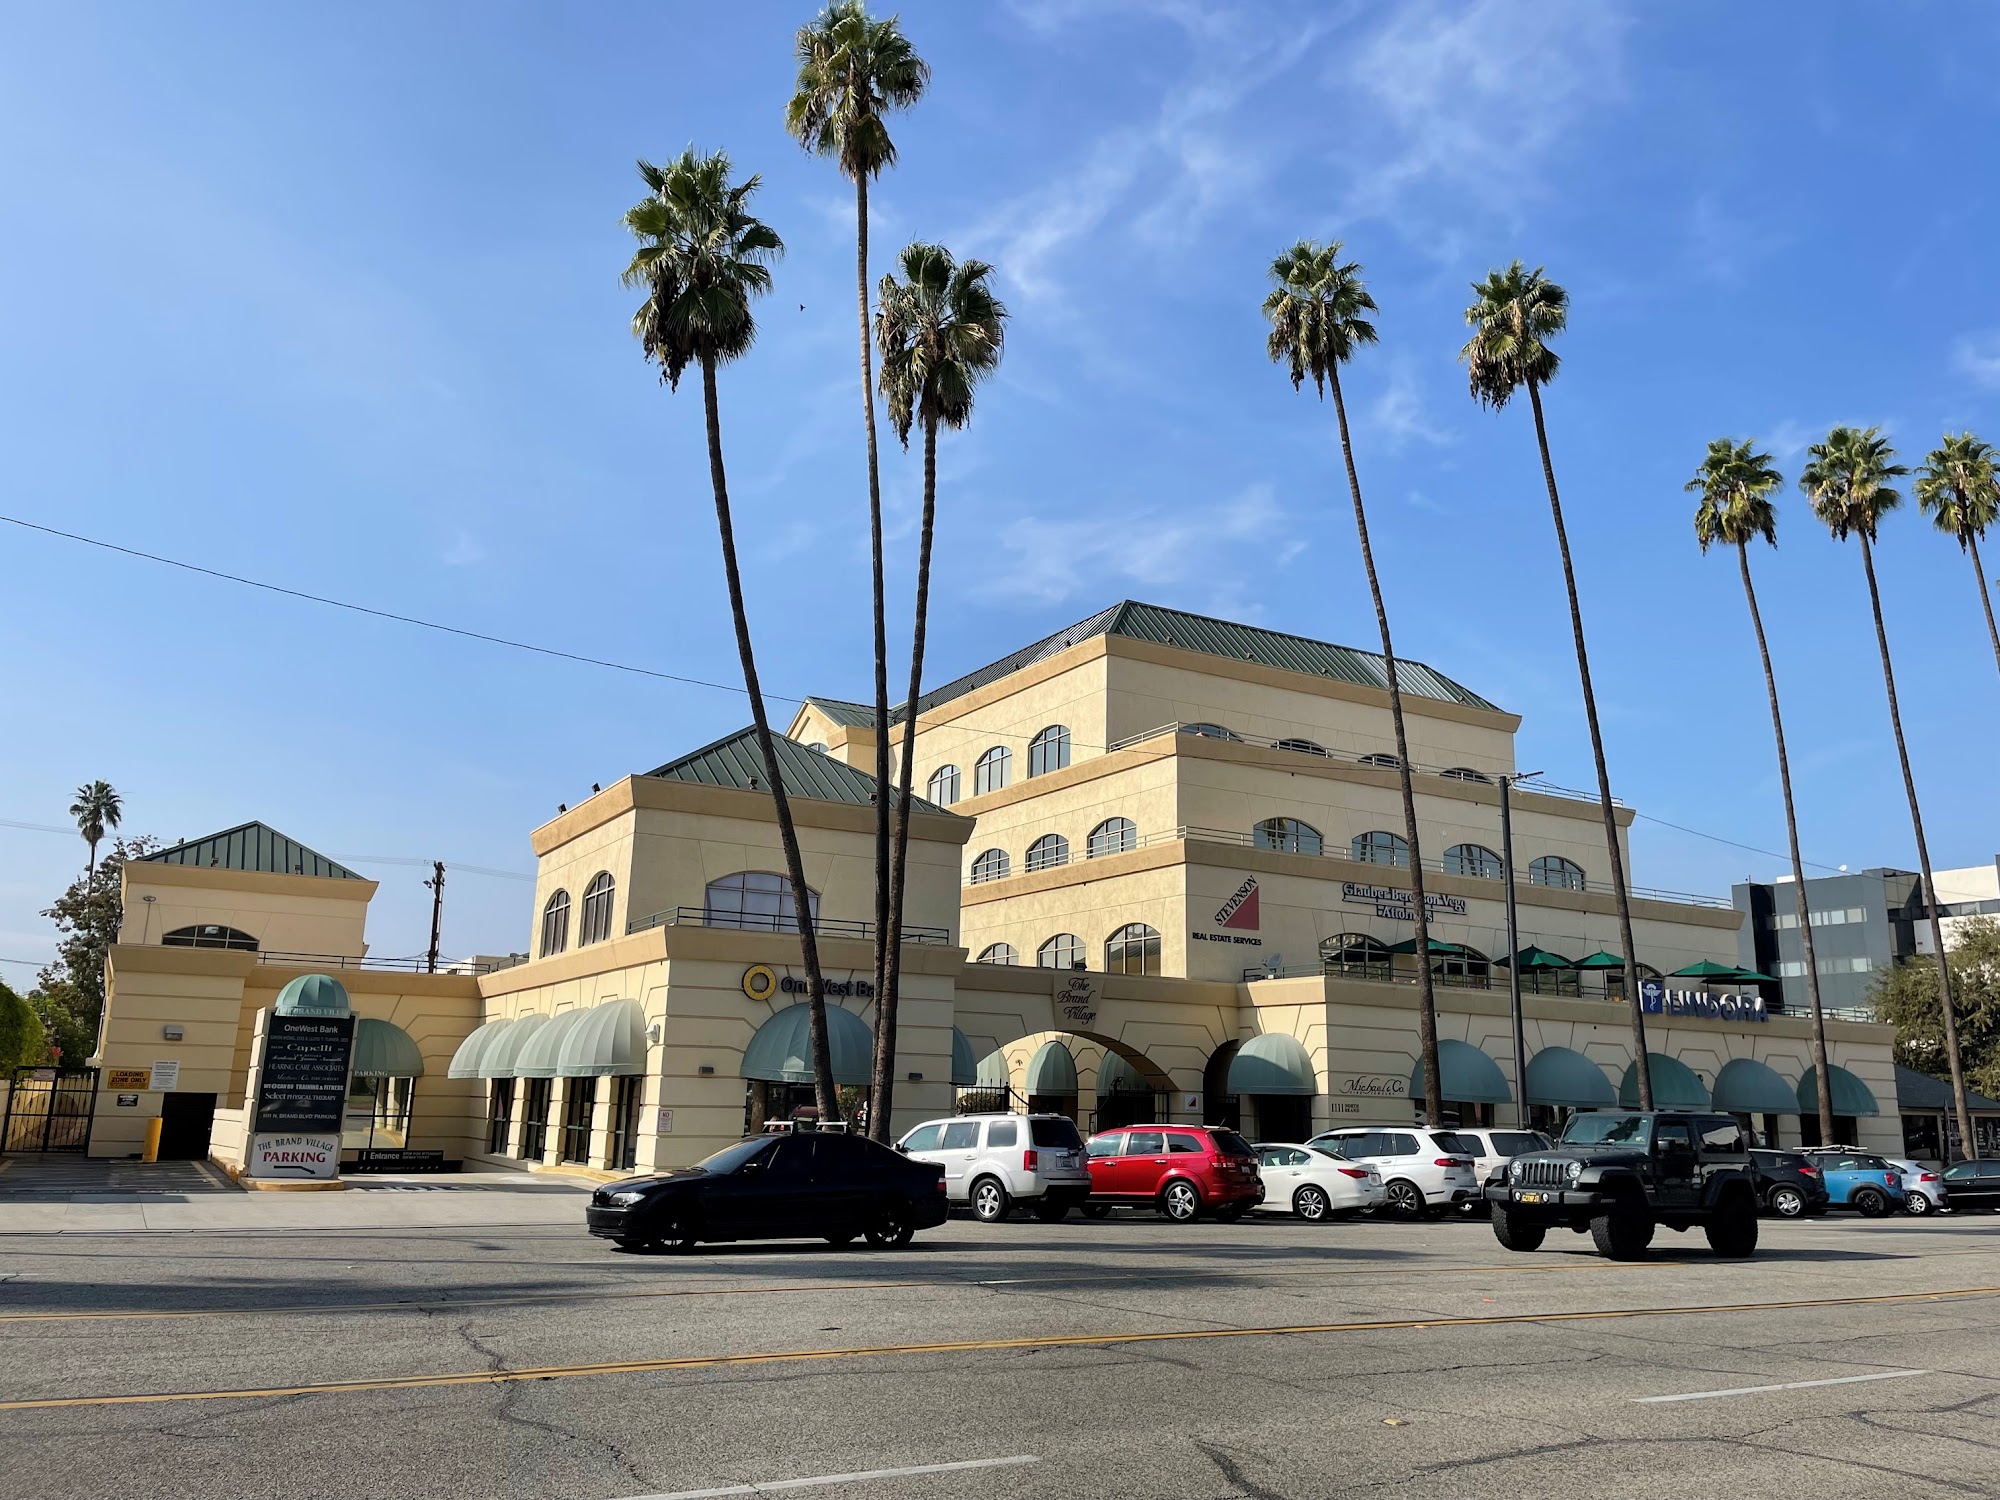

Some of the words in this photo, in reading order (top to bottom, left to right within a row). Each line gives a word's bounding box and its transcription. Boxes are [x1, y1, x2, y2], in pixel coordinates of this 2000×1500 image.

[1343, 882, 1390, 899] Glauber
[1214, 874, 1258, 926] STEVENSON
[1192, 932, 1208, 941] REAL
[1210, 934, 1232, 943] ESTATE
[1233, 936, 1262, 946] SERVICES
[1068, 977, 1090, 991] The
[1057, 990, 1096, 1004] Brand
[1665, 988, 1769, 1022] LINDORA
[1063, 1006, 1096, 1025] Village
[284, 1024, 318, 1032] OneWest
[320, 1025, 338, 1034] Bank
[1332, 1103, 1343, 1112] 1111
[258, 1141, 271, 1151] THE
[276, 1137, 302, 1147] BRAND
[306, 1138, 334, 1152] VILLAGE
[263, 1152, 326, 1162] PARKING
